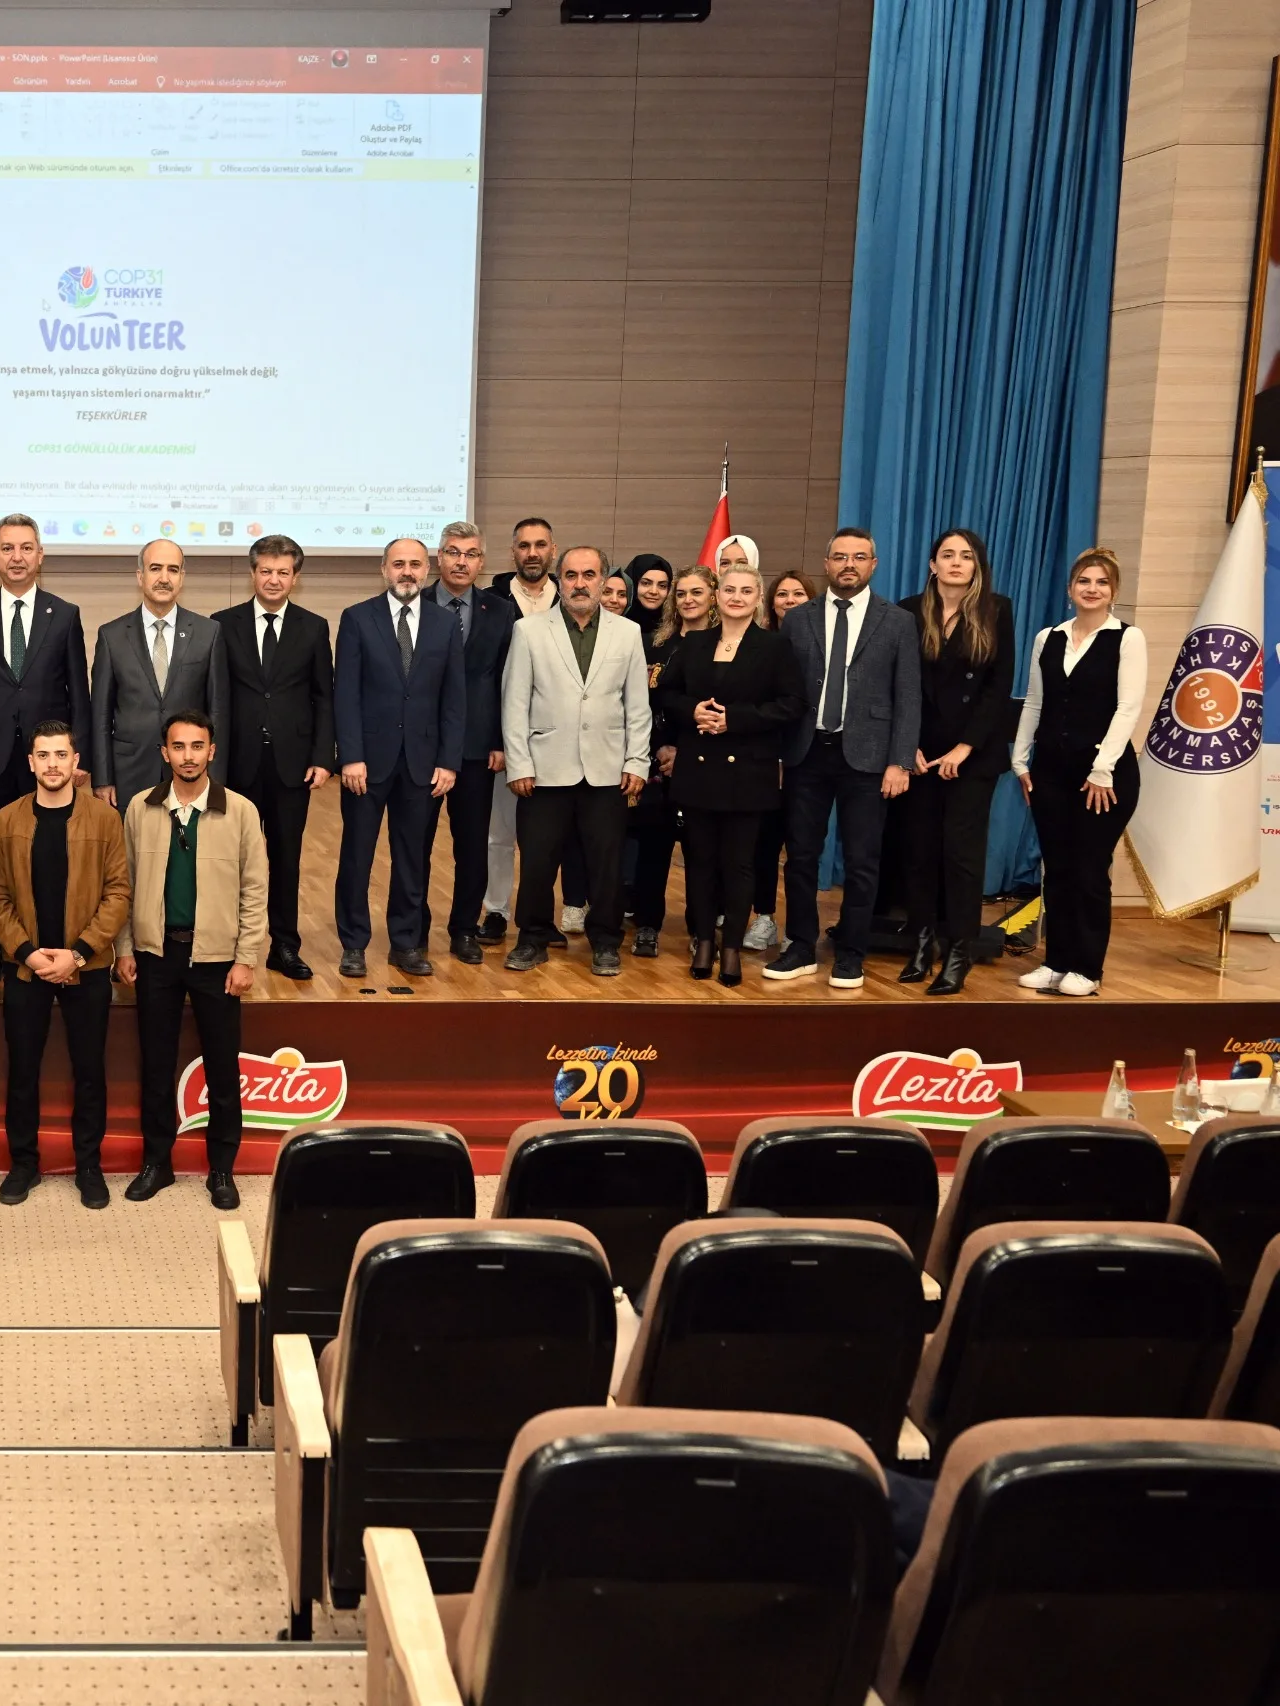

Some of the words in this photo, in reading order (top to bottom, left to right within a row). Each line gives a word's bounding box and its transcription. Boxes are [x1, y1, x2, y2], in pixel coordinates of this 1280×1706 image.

[59, 53, 101, 63] PowerPoint
[13, 76, 49, 86] Görünüm
[108, 77, 138, 86] Acrobat
[184, 78, 215, 88] yapmak
[257, 78, 287, 88] söyleyin
[370, 124, 396, 133] Adobe
[397, 124, 412, 133] PDF
[360, 135, 388, 145] Oluştur
[399, 135, 422, 145] Paylaş
[366, 149, 388, 157] Adobe
[389, 149, 414, 157] Acrobat
[90, 164, 117, 172] oturum
[300, 164, 323, 173] olarak
[104, 268, 164, 286] COP31
[104, 287, 163, 299] TÜRKİYE
[38, 317, 187, 352] VOLUNTEER
[20, 363, 57, 377] etmek,
[58, 363, 100, 377] yalnızca
[101, 363, 158, 377] gökyüzüne
[159, 363, 191, 378] doğru
[193, 363, 248, 377] yükselmek
[250, 365, 279, 379] değil;
[12, 387, 49, 400] yaşamı
[51, 387, 89, 400] taşıyan
[90, 387, 142, 399] sistemleri
[75, 409, 147, 422] TEŞEKKÜRLER
[27, 443, 62, 455] COP31
[63, 443, 135, 455] GÖNÜLLÜLÜK
[137, 443, 196, 455] AKADEMİSİ
[64, 481, 76, 489] Bir
[78, 481, 100, 490] daha
[230, 482, 265, 493] yalnızca
[267, 483, 288, 491] akan
[290, 485, 311, 494] suyu
[415, 522, 435, 530] 11:14
[1188, 676, 1225, 726] 1992
[546, 1044, 608, 1061] Lezzetin
[610, 1042, 659, 1060] İzinde
[560, 1060, 640, 1112] 20
[872, 1057, 1003, 1106] Lezita
